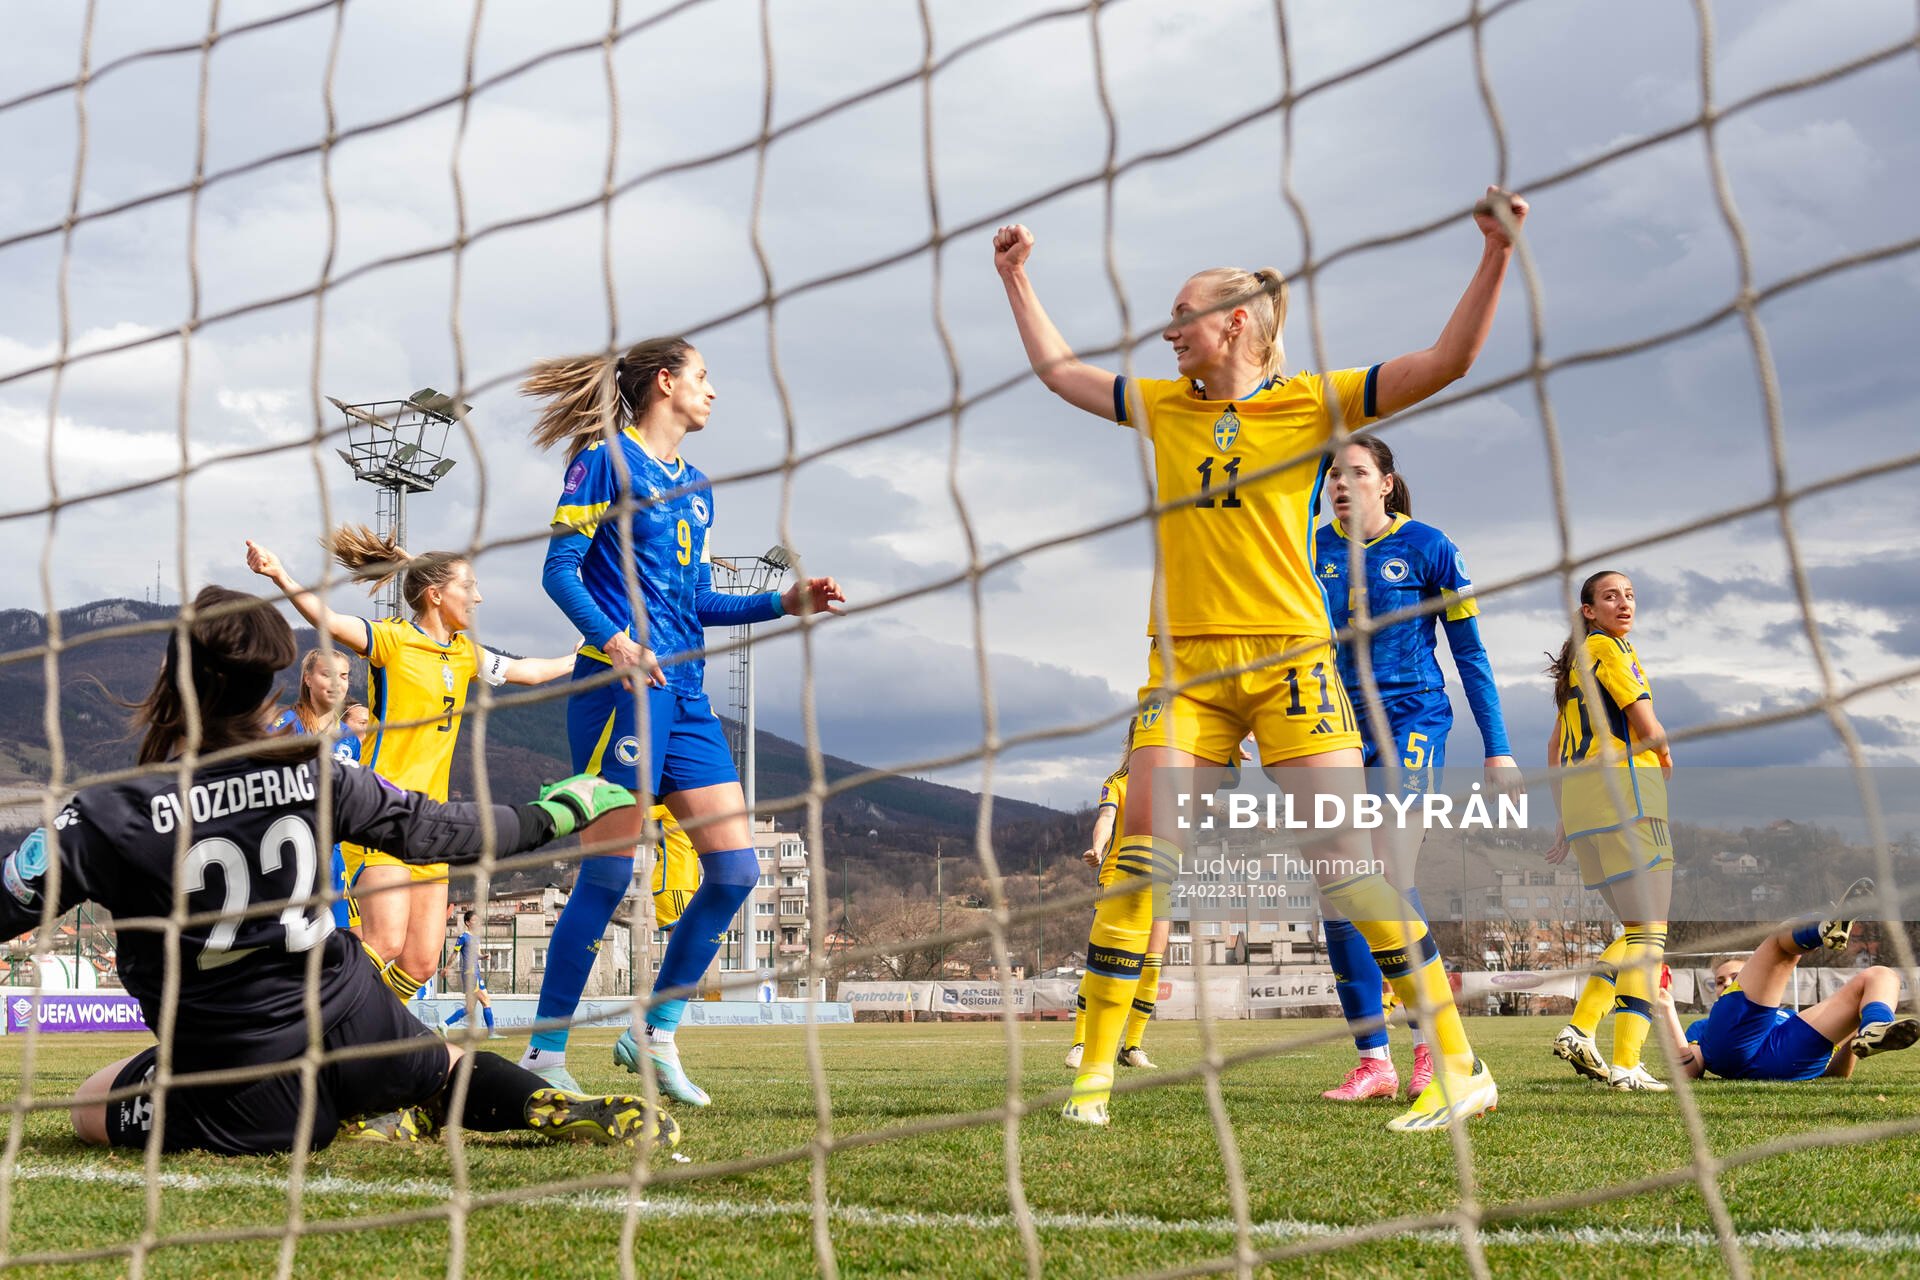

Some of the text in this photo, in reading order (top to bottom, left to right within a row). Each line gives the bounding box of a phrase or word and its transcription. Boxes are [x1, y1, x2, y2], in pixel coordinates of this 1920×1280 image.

[1195, 456, 1242, 508] 11
[676, 519, 692, 566] 9
[1283, 662, 1336, 716] 11
[437, 695, 456, 733] 3
[1403, 731, 1428, 771] 5
[150, 763, 316, 834] GVOZDERAC
[182, 814, 337, 971] 22
[37, 1004, 76, 1023] UEFA
[1250, 985, 1318, 998] KELME
